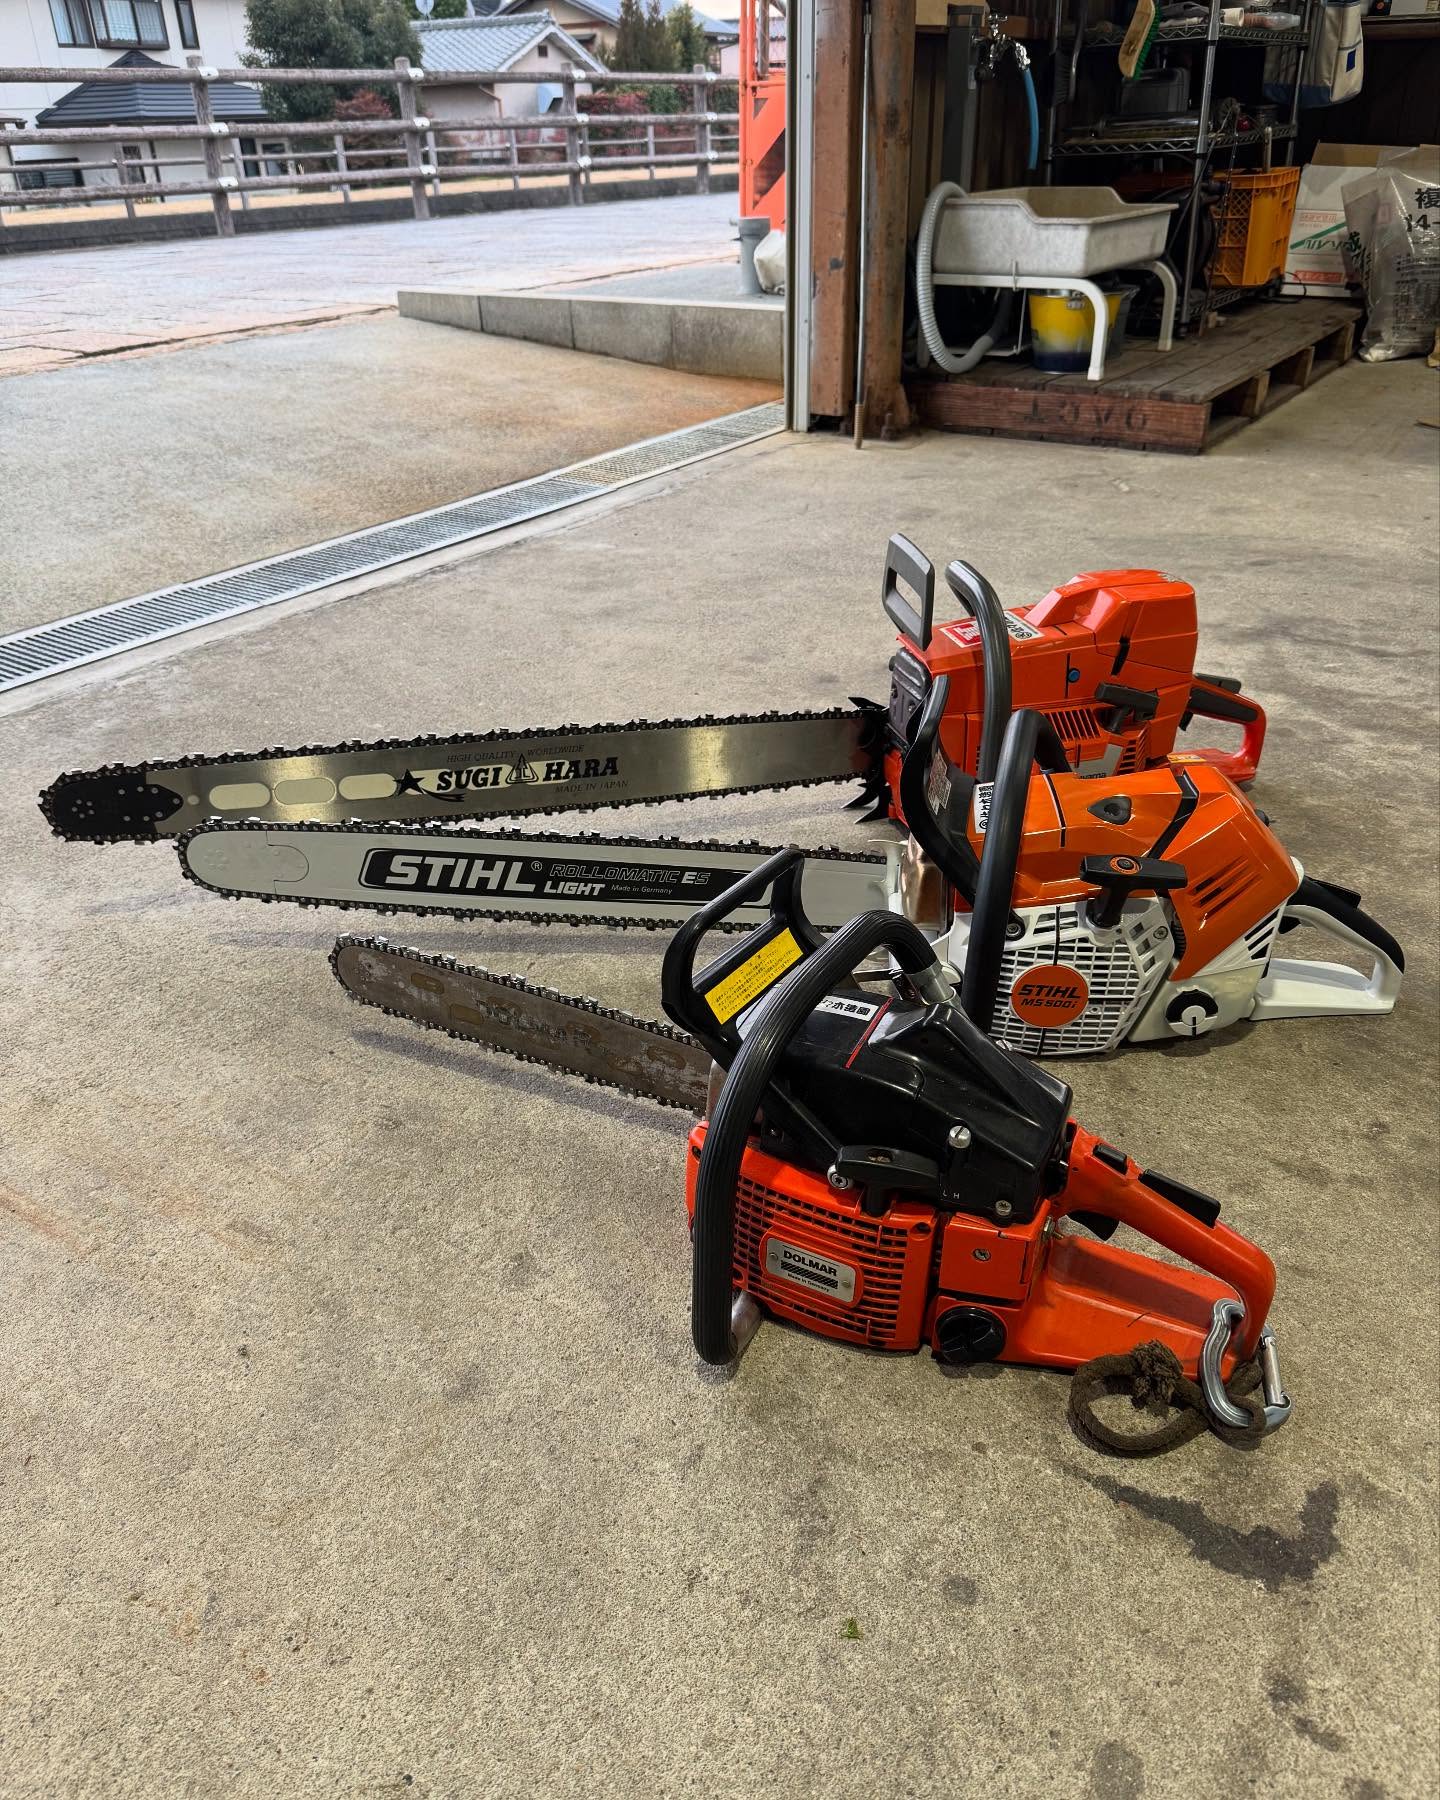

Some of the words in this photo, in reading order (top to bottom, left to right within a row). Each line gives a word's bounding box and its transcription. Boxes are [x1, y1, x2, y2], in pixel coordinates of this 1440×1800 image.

[447, 752, 471, 763] HIGH
[474, 750, 515, 762] QUALITY
[528, 744, 585, 757] WORLDWIDE
[436, 766, 503, 791] SUGI
[543, 757, 619, 782] HARA
[555, 784, 583, 794] MADE
[586, 783, 596, 792] IN
[600, 780, 629, 790] JAPAN
[550, 863, 681, 884] ROLLOMATIC
[681, 871, 712, 885] ES
[543, 880, 606, 896] LIGHT
[611, 884, 631, 892] Made
[641, 886, 673, 895] Germany
[1017, 984, 1081, 999] STIHL
[783, 1249, 837, 1277] DOLMAR
